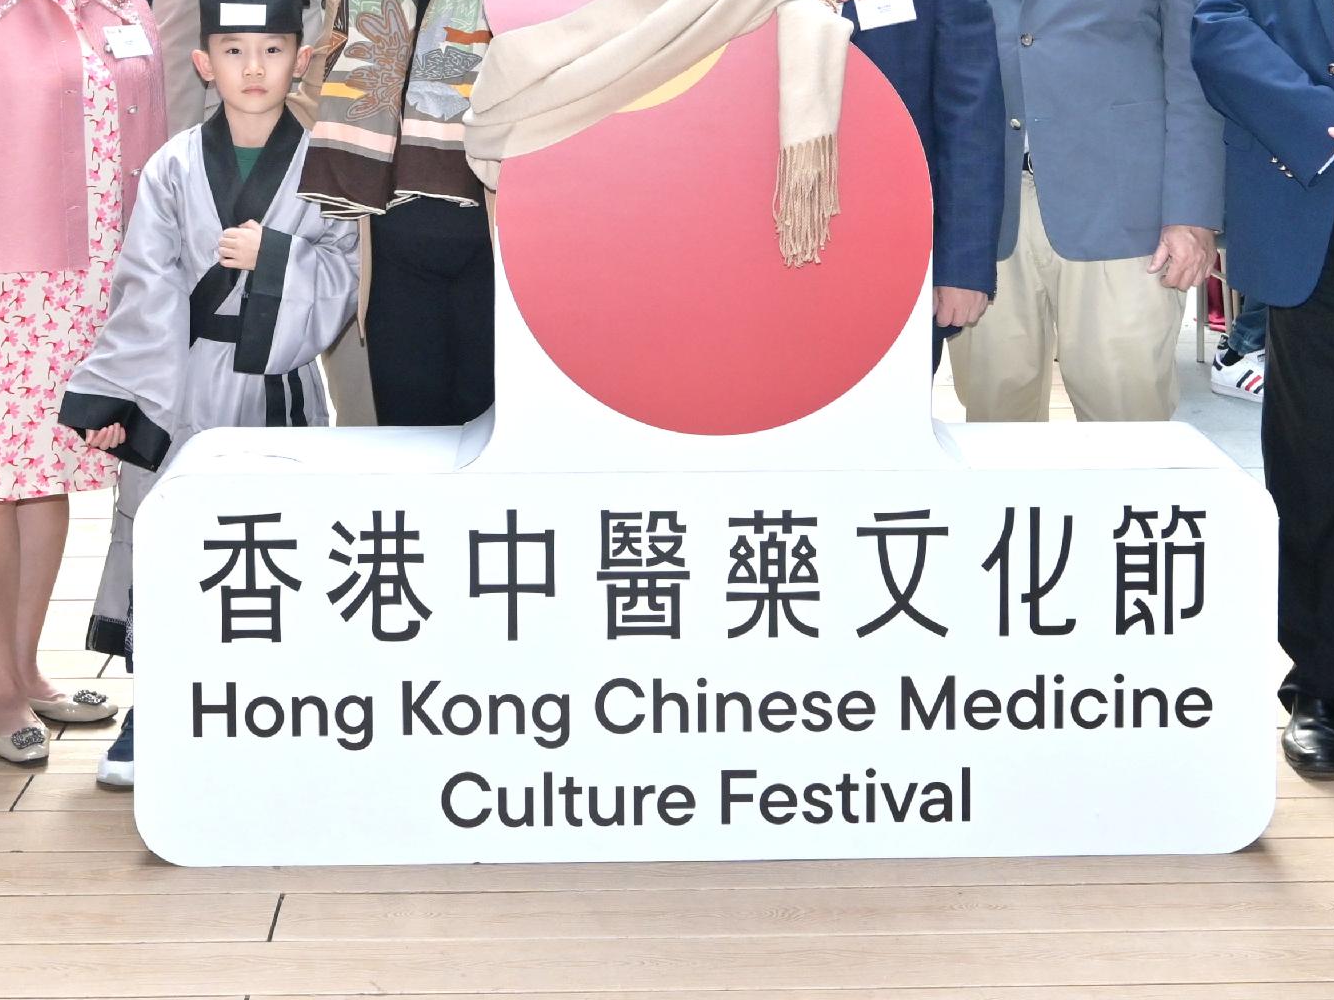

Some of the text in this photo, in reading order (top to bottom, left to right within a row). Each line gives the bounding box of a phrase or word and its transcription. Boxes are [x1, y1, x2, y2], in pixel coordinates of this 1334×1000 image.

[200, 505, 1206, 643] 香港中醫藥文化節
[193, 674, 1212, 750] Hong Kong Chinese Medicine
[442, 767, 970, 828] Culture Festival
